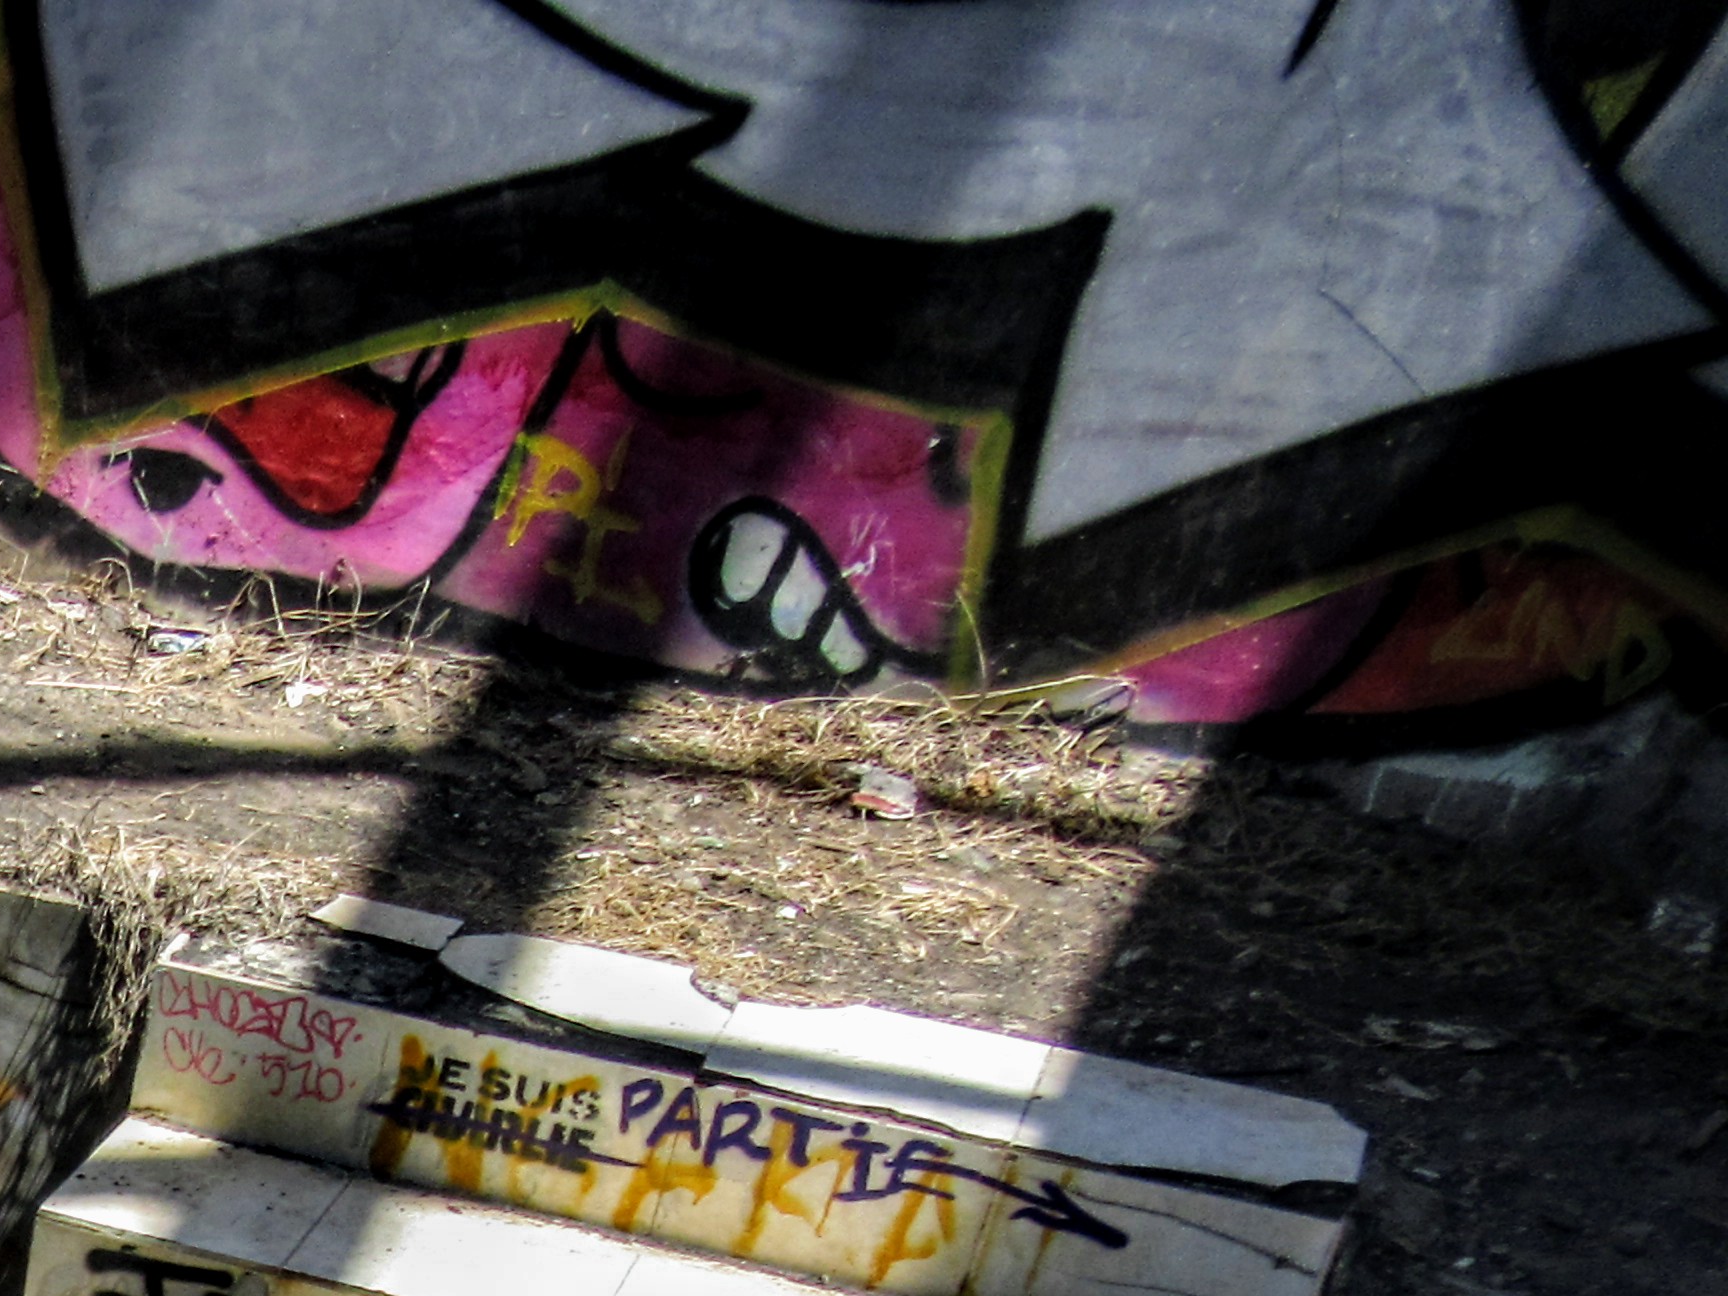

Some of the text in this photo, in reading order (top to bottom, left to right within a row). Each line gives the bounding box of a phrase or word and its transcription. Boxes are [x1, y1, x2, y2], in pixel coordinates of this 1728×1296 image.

[398, 1053, 600, 1121] JE SUIS
[619, 1076, 956, 1203] PARTIE
